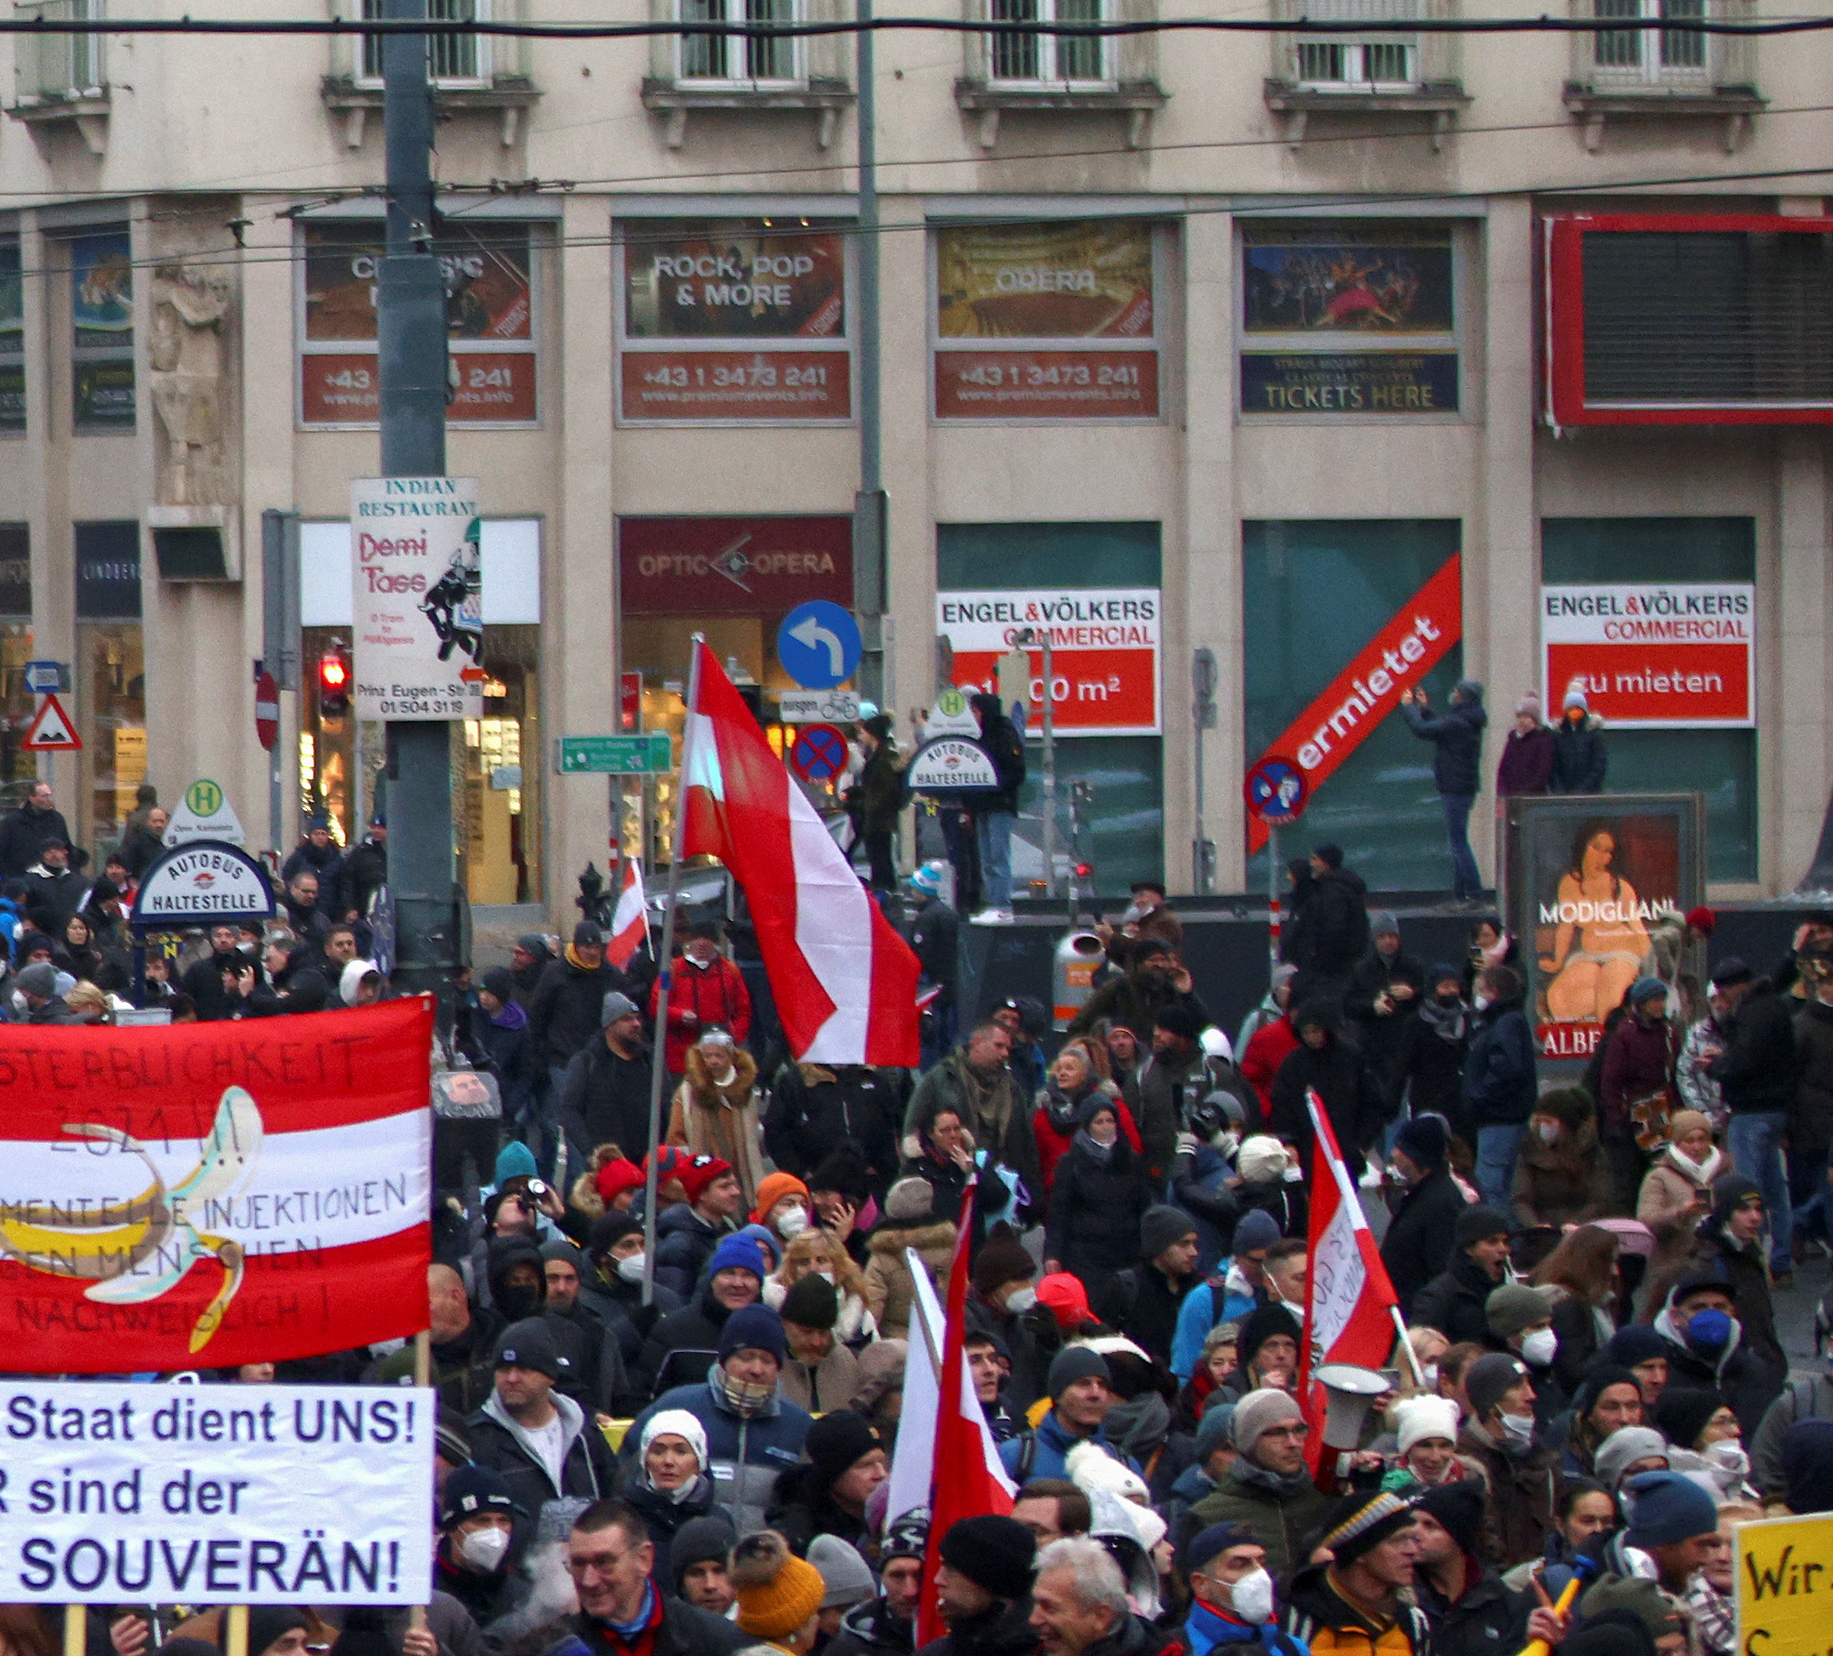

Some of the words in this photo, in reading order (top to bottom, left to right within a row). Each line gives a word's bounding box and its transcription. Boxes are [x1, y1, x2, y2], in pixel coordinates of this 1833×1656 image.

[753, 255, 814, 278] POP
[996, 268, 1097, 293] OPERA
[677, 285, 696, 306] &
[704, 284, 792, 306] MORE
[469, 368, 512, 388] 241
[785, 367, 827, 387] 241
[1027, 366, 1090, 386] 3473
[1098, 365, 1139, 385] 241
[1266, 386, 1363, 408] TICKETS
[1371, 385, 1434, 407] HERE
[386, 480, 456, 495] INDIAN
[359, 501, 477, 517] RESTAURANT
[360, 529, 428, 562] Demi
[638, 554, 710, 577] OPTIC
[753, 553, 836, 575] OPERA
[361, 566, 427, 594] Tass
[942, 597, 1156, 623] ENGEL&VÖLKERS
[1546, 591, 1749, 617] ENGEL&VÖLKERS
[1604, 620, 1749, 640] COMMERCIAL
[357, 684, 386, 697] Prinz
[1296, 615, 1441, 770] ermietet
[1615, 667, 1724, 694] mieten
[401, 701, 429, 714] 504
[927, 742, 982, 763] AUTOBUS
[916, 772, 990, 784] HALTESTELLE
[167, 855, 245, 881] AUTOBUS
[152, 894, 259, 912] HALTESTELLE
[1539, 899, 1677, 925] MODIGLIANI
[203, 1172, 410, 1231] INJEKTIONEN
[97, 1236, 325, 1278] MENSCHEN
[6, 1396, 135, 1442] Staat
[151, 1398, 276, 1442] dient
[294, 1400, 416, 1445] UNS!
[28, 1468, 141, 1515] sind
[162, 1470, 249, 1516] der
[19, 1529, 401, 1594] SOUVERÄN!
[1745, 1546, 1824, 1601] Wir
